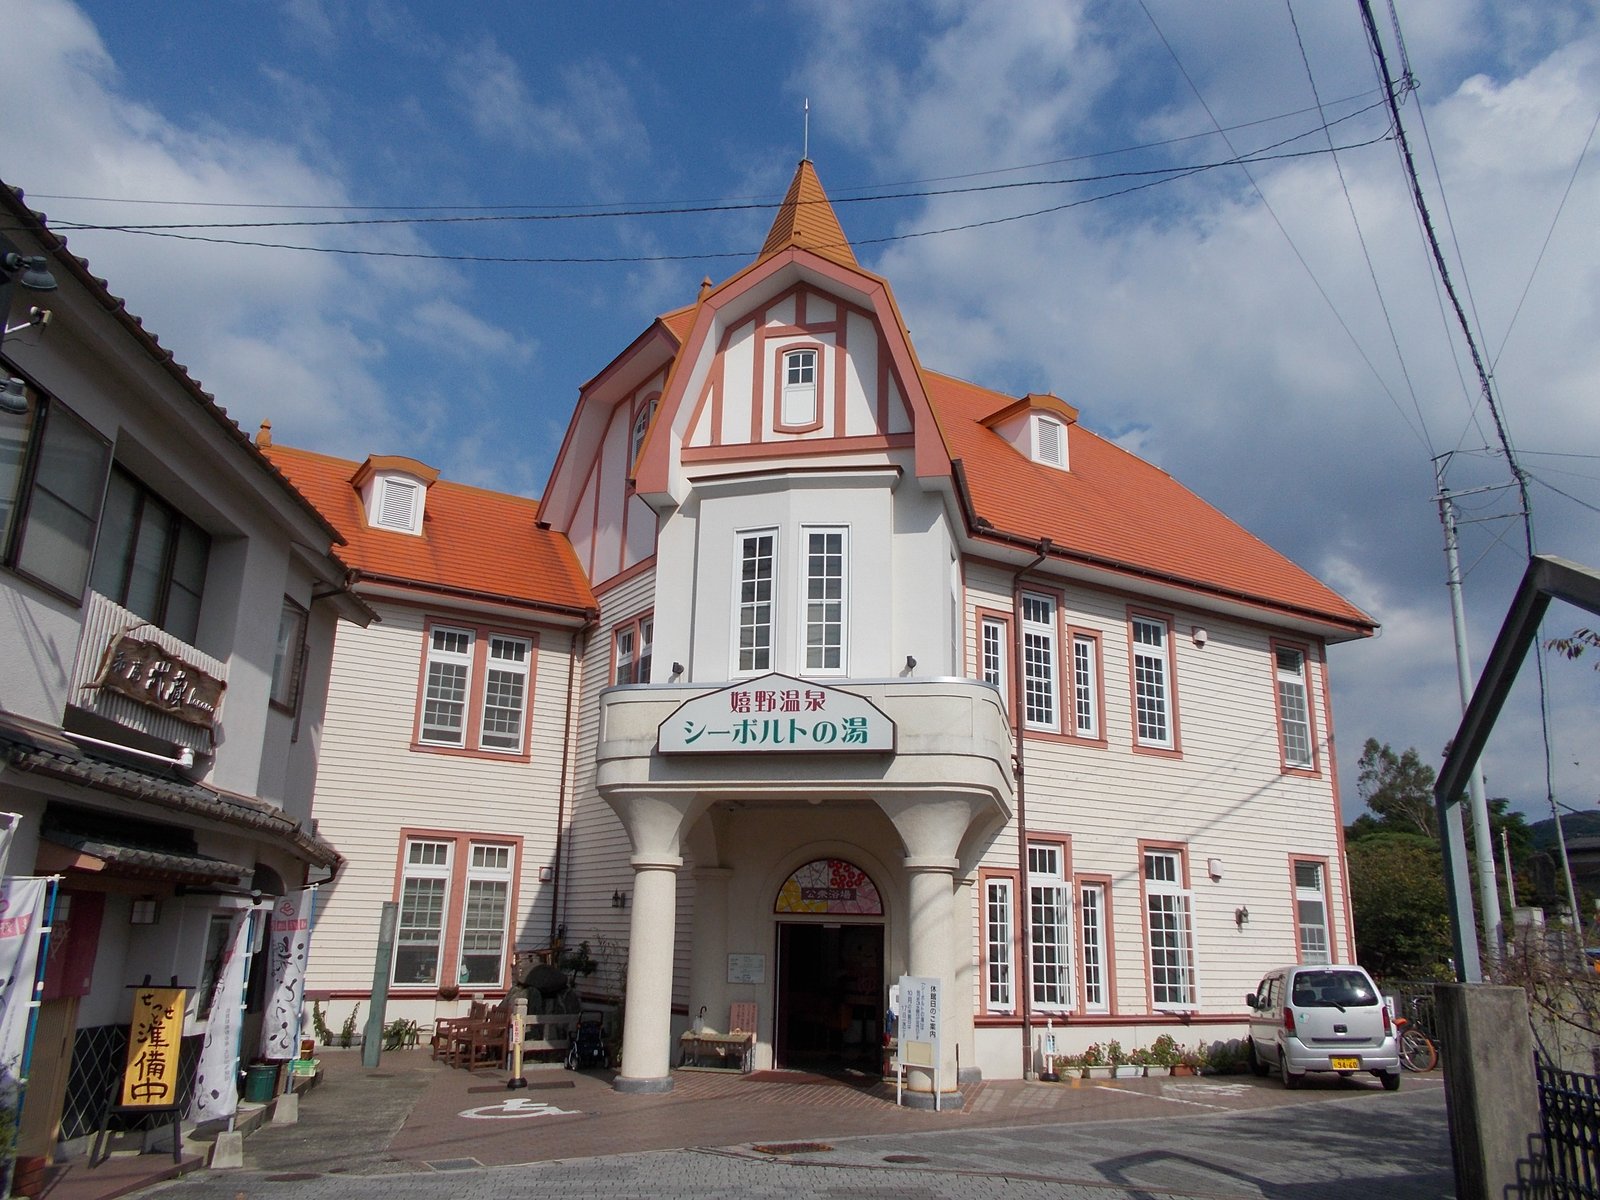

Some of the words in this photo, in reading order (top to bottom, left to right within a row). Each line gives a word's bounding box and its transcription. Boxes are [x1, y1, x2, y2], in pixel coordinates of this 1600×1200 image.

[730, 689, 826, 713] 嬉野温泉
[683, 716, 868, 745] シーボルトの湯
[806, 889, 851, 899] 公衆浴場
[131, 1021, 169, 1103] 準備中
